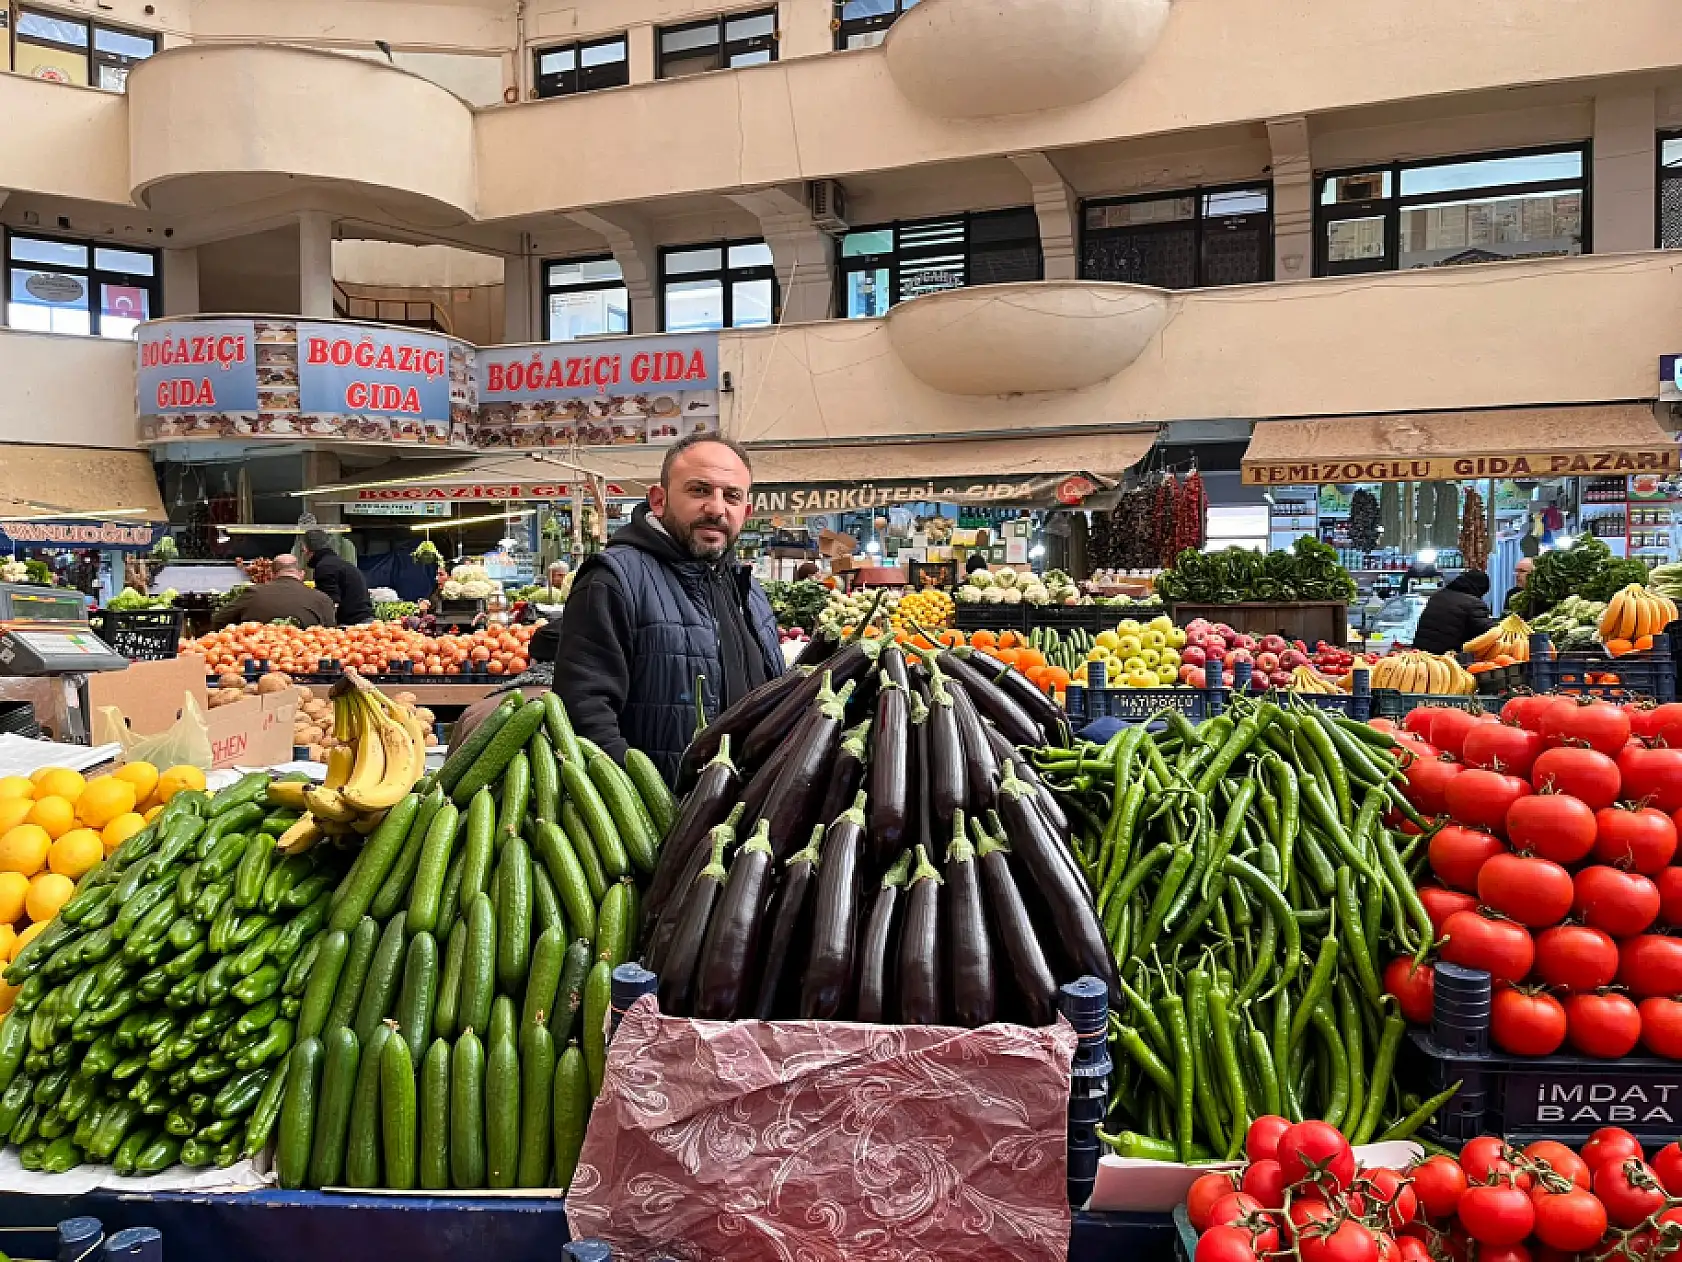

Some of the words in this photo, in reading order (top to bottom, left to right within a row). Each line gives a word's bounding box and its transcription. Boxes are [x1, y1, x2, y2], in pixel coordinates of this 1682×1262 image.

[630, 348, 708, 383] GIDA
[157, 377, 216, 408] GIDA
[345, 381, 422, 414] GIDA
[1453, 457, 1532, 475] GIDA
[1550, 451, 1670, 472] PAZARI
[1537, 1105, 1675, 1122] BABA
